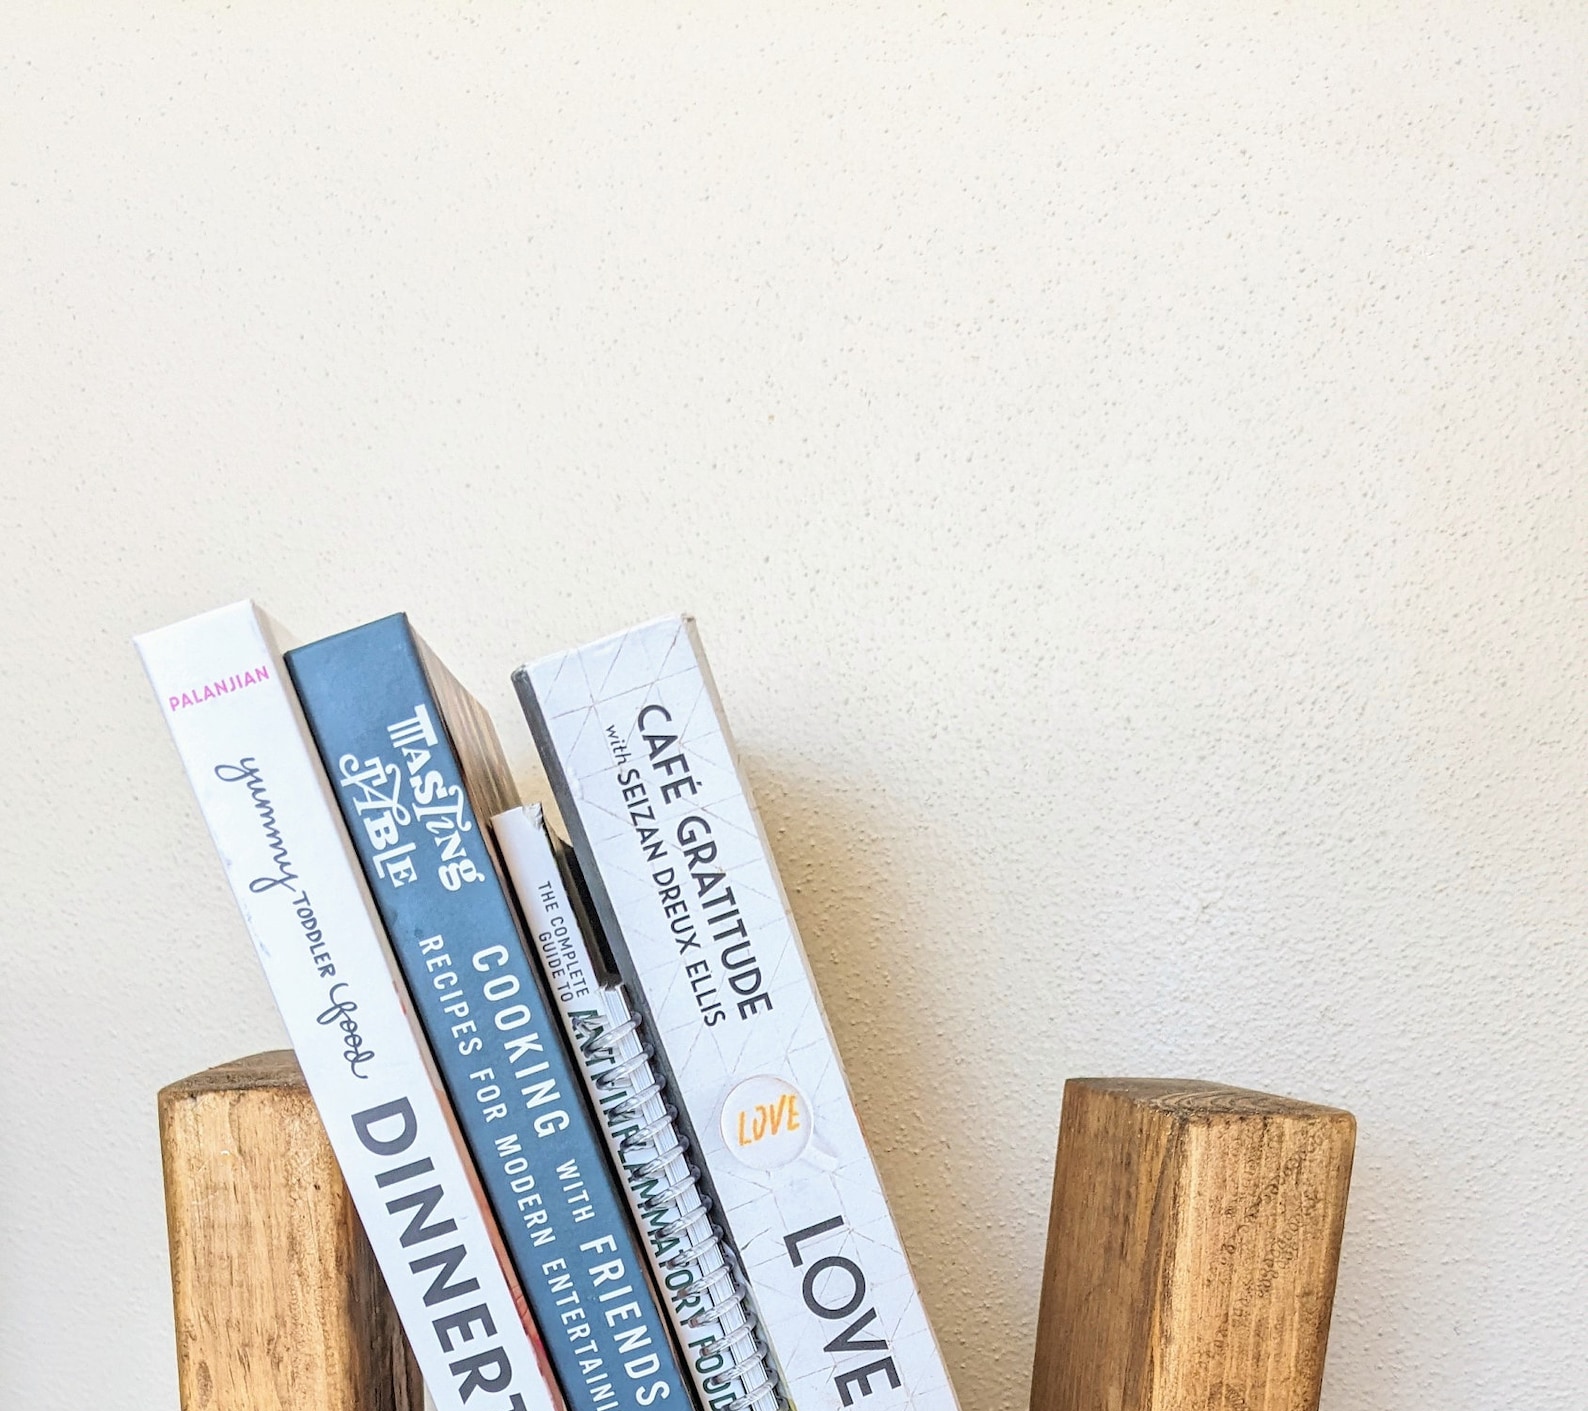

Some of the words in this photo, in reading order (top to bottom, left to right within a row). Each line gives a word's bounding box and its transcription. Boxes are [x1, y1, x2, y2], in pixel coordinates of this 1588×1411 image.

[169, 666, 269, 712] PALANJIAN
[607, 723, 628, 765] with
[214, 756, 298, 893] yummy
[292, 890, 335, 978] TODDLER
[339, 753, 418, 888] TABLE
[616, 768, 668, 864] SEIZAN
[638, 704, 704, 805] CAFÉ
[677, 815, 773, 1022] GRATITUDE
[538, 881, 559, 912] THE
[550, 916, 590, 996] COMPLETE
[652, 868, 702, 955] DREUX
[539, 932, 566, 979] GUIDE
[560, 982, 574, 1003] TO
[686, 960, 727, 1029] ELLIS
[419, 935, 483, 1056] RECIPES
[470, 1069, 508, 1123] FOR
[494, 1134, 556, 1247] MODERN
[738, 1094, 800, 1147] LOVE
[471, 945, 569, 1138] COOKING
[557, 1159, 595, 1224] WITH
[580, 1234, 670, 1406] FRIENDS
[783, 1214, 902, 1408] LOVE
